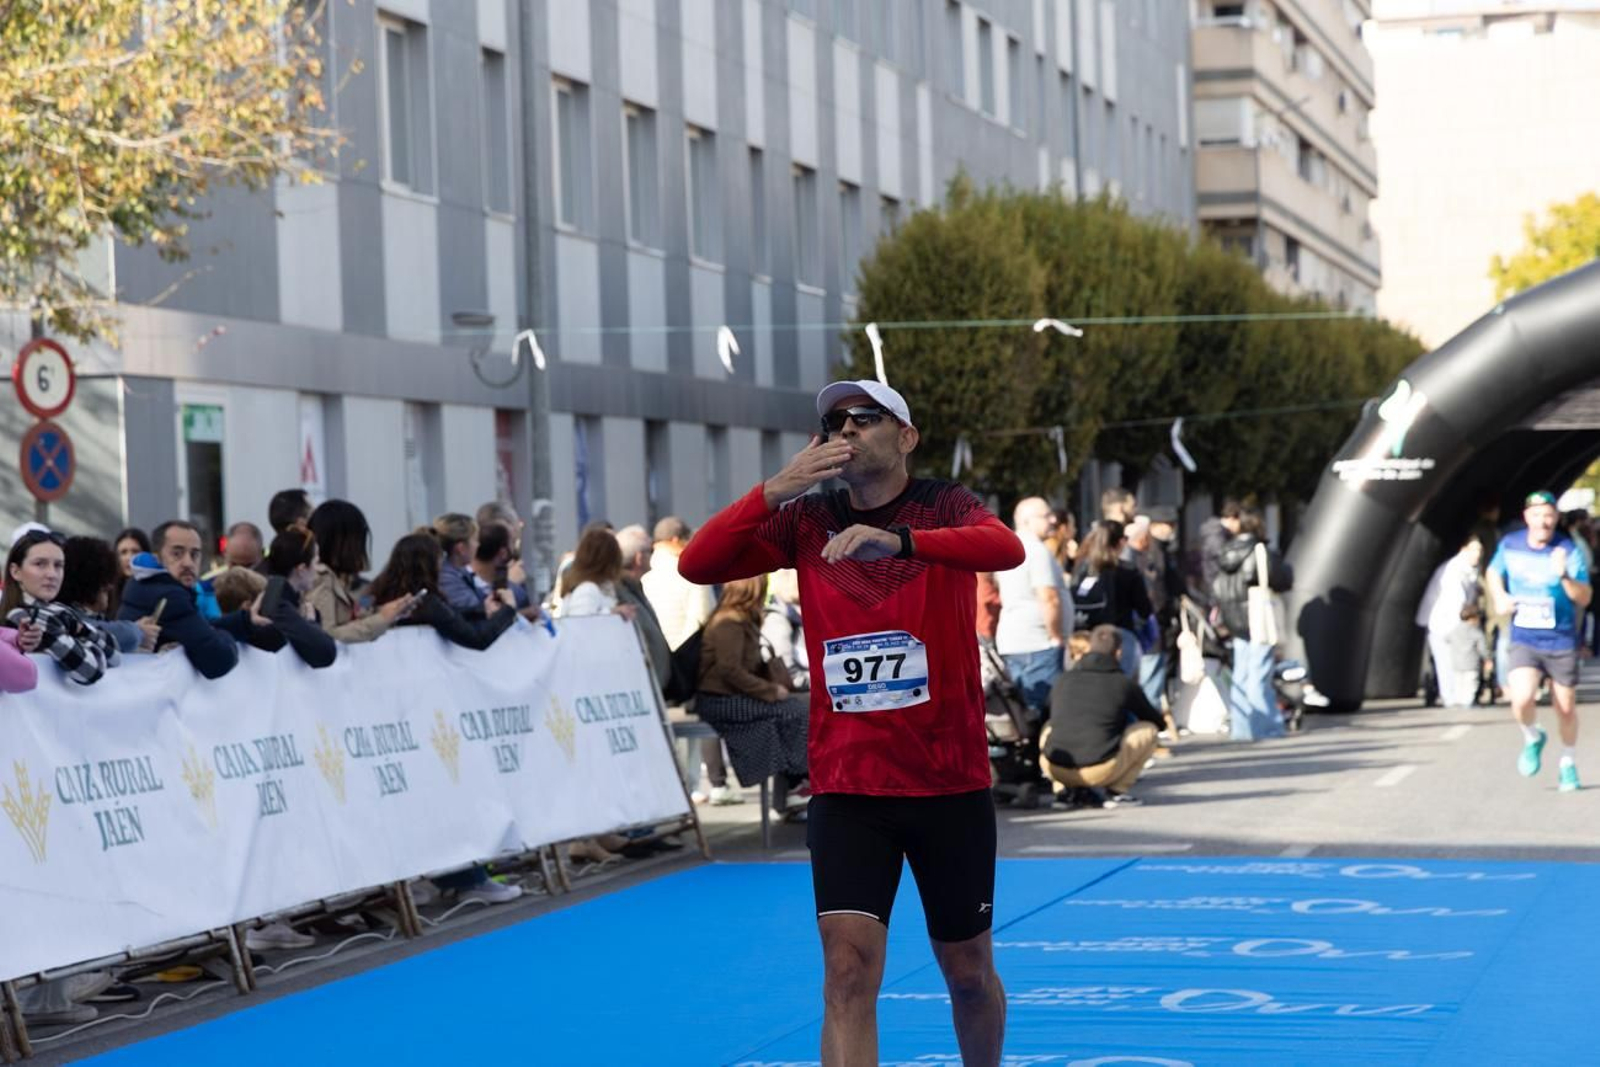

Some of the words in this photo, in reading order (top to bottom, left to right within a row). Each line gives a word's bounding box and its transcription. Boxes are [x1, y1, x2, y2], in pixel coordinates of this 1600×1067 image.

[37, 364, 49, 392] 6
[843, 653, 906, 683] 977
[213, 742, 260, 779] CAJA
[492, 739, 520, 773] AÉN
[98, 756, 164, 798] RURAL
[373, 758, 408, 797] AÉN
[94, 801, 145, 851] JAÉN
